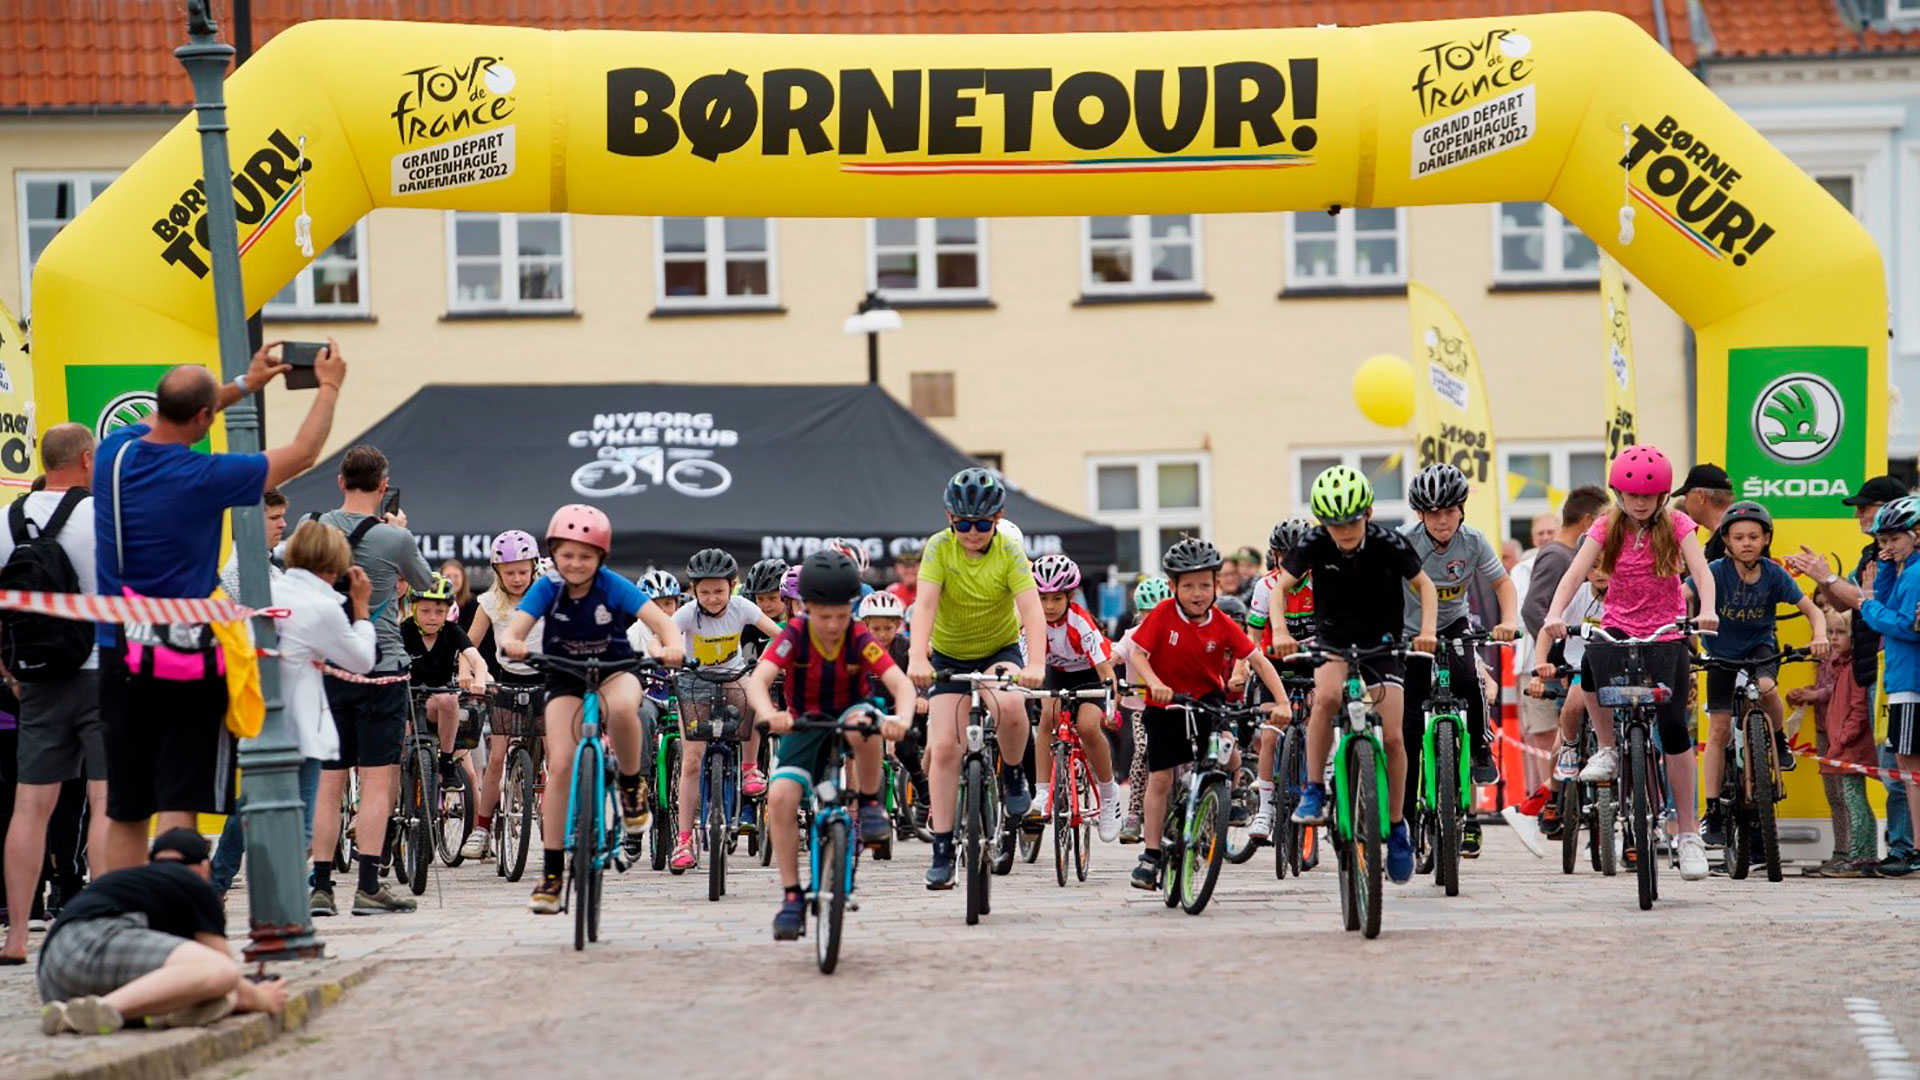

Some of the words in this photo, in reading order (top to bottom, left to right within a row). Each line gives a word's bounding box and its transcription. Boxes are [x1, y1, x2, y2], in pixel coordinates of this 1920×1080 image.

[469, 86, 487, 102] de
[606, 57, 1319, 162] BØRNETOUR!
[1423, 116, 1470, 143] GRAND
[1430, 112, 1518, 156] COPENHAGUE
[402, 148, 449, 169] GRAND
[1419, 137, 1495, 174] DANEMARK
[1500, 125, 1528, 146] 2022
[1654, 115, 1742, 191] BØRNE
[399, 171, 475, 192] DANEMARK
[480, 164, 508, 180] 2022
[409, 151, 497, 180] COPENHAGUE
[1618, 124, 1776, 266] TOUR!
[593, 411, 714, 430] NYBORG
[568, 427, 659, 447] CYKLE
[664, 427, 739, 447] KLUB
[1743, 475, 1849, 498] ŠKODA
